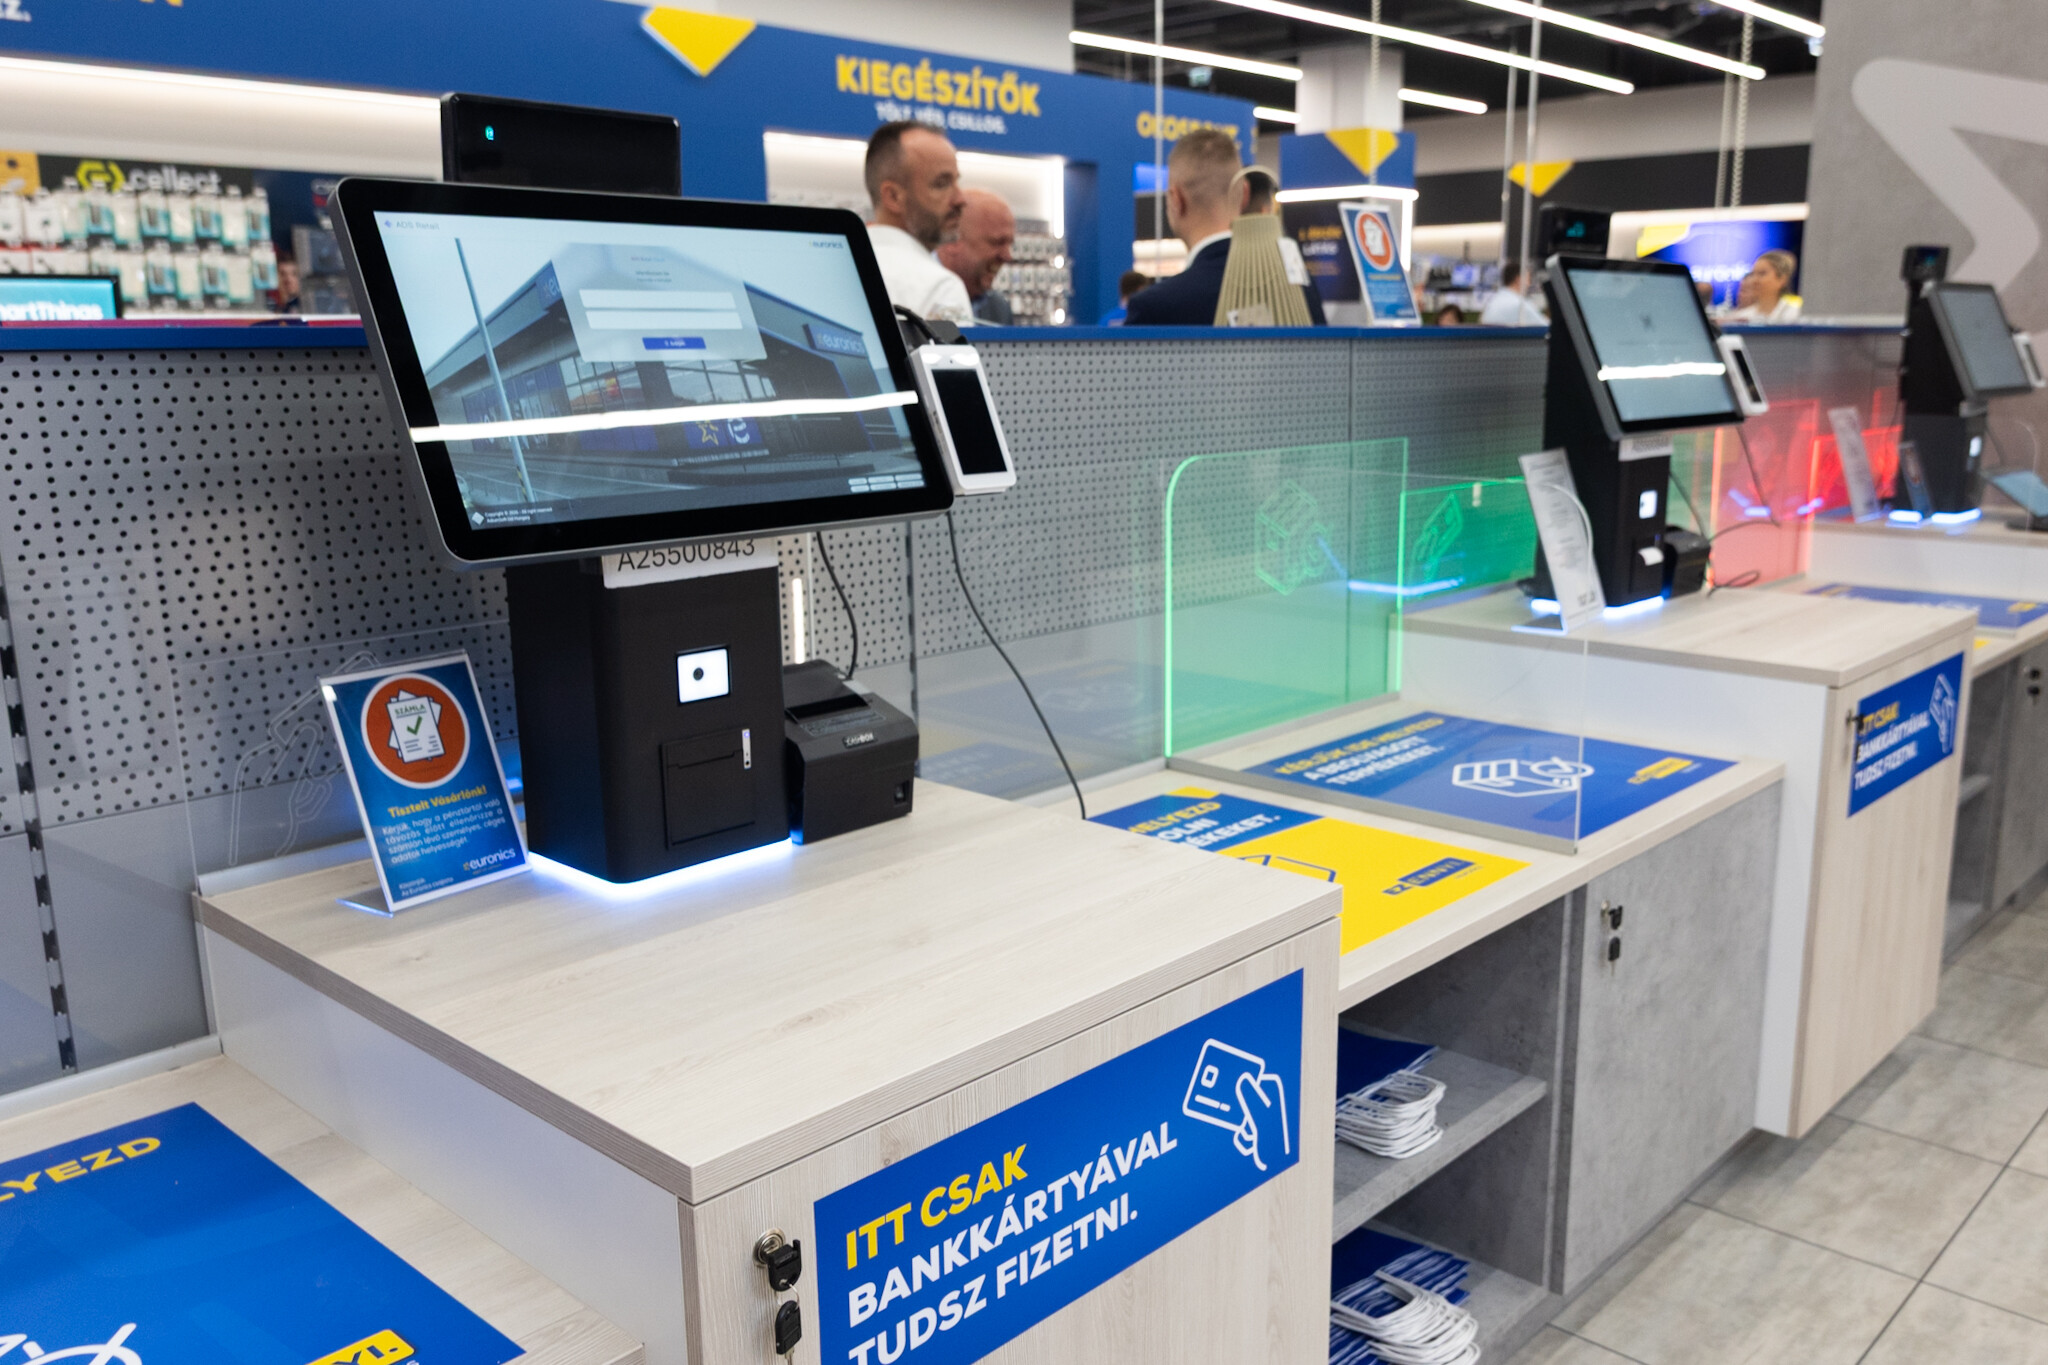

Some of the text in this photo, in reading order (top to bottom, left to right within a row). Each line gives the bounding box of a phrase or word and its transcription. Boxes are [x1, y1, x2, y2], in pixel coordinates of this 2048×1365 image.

[835, 54, 1041, 117] KIEGÉSZÍTŐK
[387, 784, 488, 818] Tisztelt Vásárlónk!
[1156, 817, 1220, 841] OLNI
[1180, 813, 1282, 848] ÉKEKET.
[469, 847, 516, 870] euronics
[0, 1137, 161, 1203] YEZD
[846, 1143, 1029, 1271] ITT CSAK
[848, 1121, 1179, 1329] BANKKÁRTYÁVAL
[848, 1192, 1138, 1365] TUDSZ FIZETNI.
